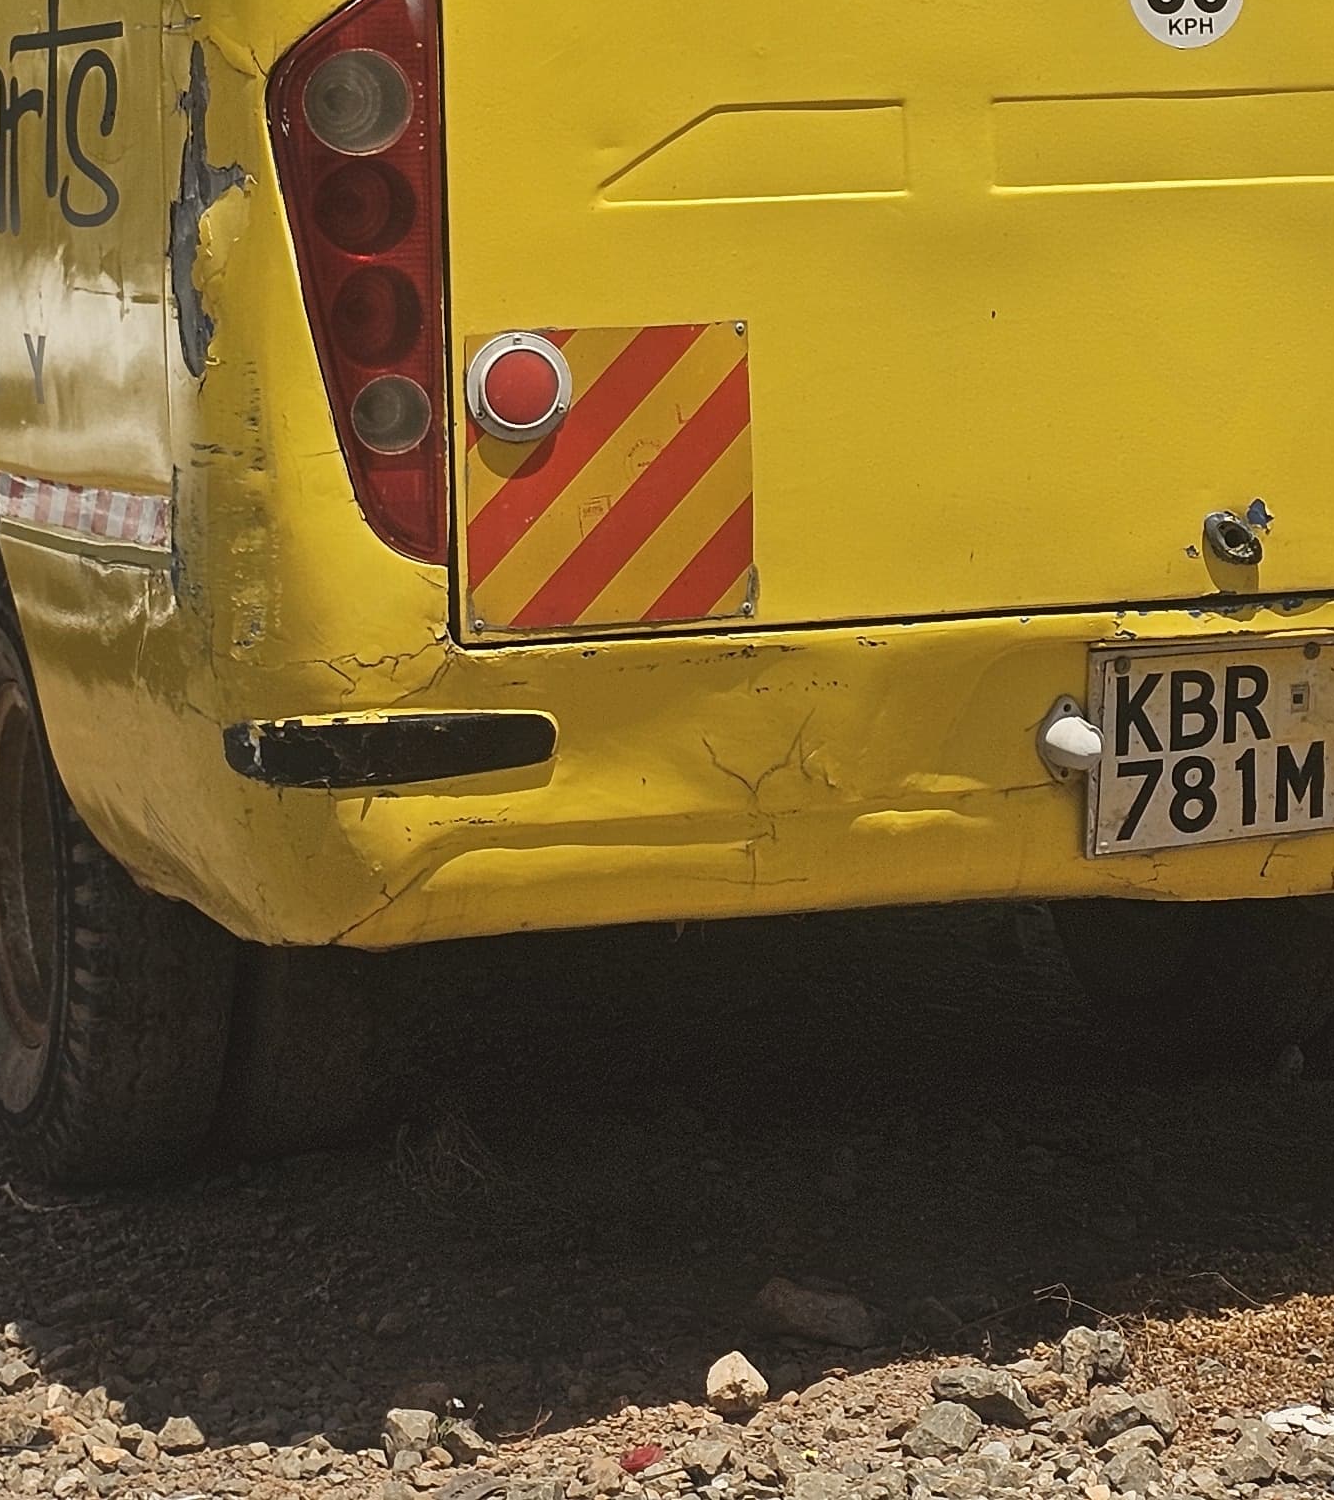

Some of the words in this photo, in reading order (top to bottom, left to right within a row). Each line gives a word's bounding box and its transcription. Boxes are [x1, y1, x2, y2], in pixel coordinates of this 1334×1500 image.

[1168, 17, 1213, 36] KPH
[1114, 664, 1271, 757] KBR
[1116, 740, 1326, 842] 781M
